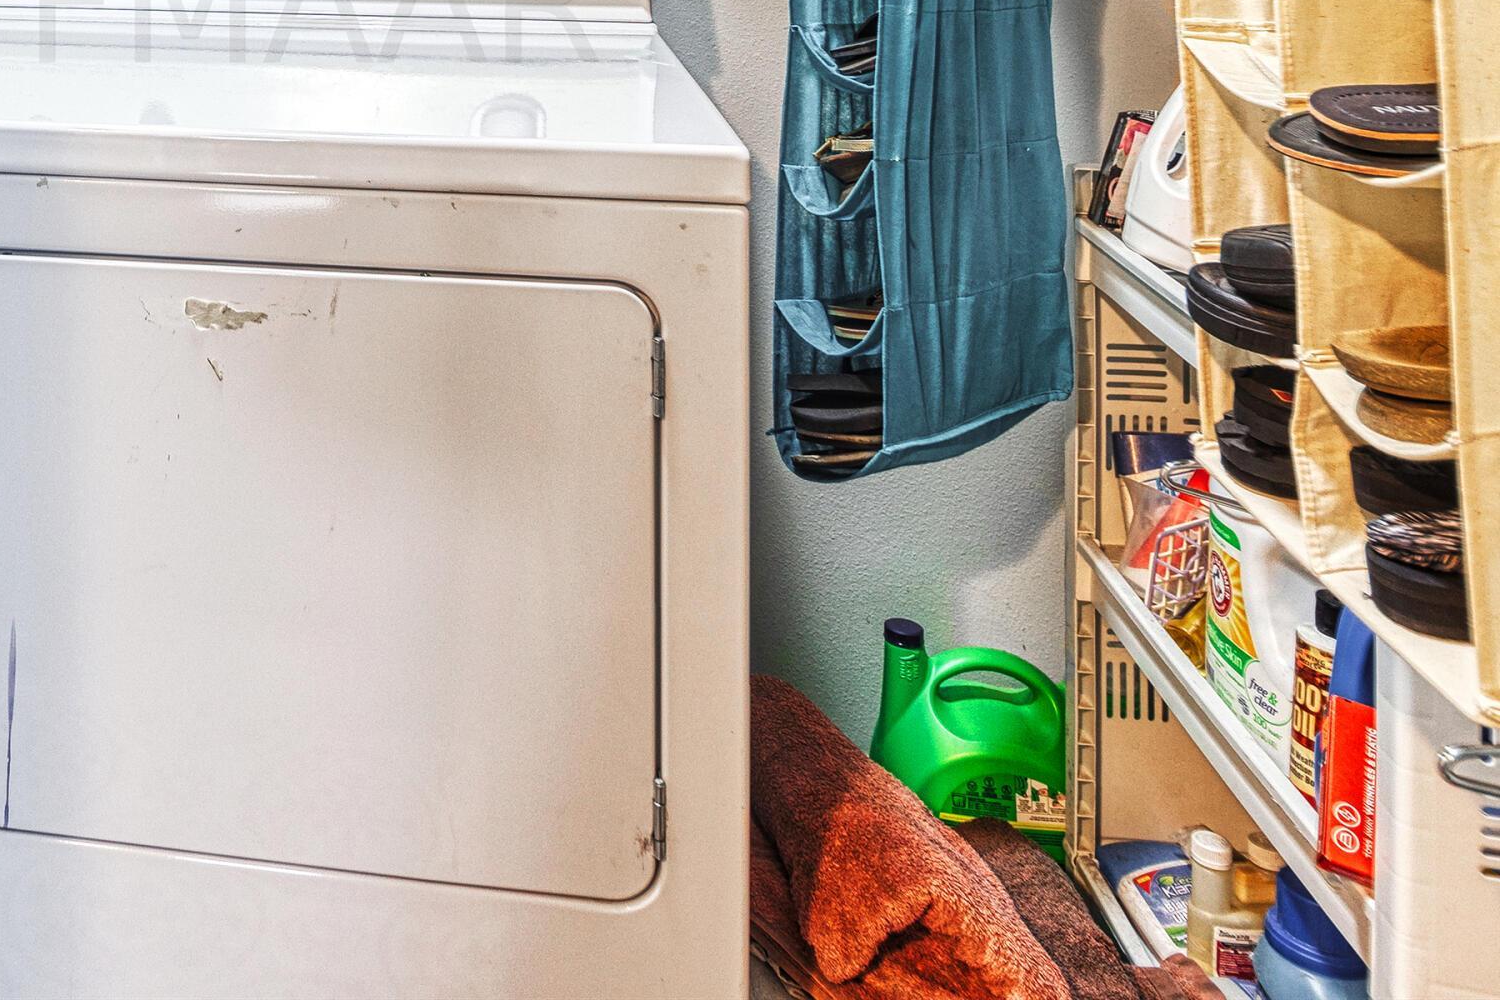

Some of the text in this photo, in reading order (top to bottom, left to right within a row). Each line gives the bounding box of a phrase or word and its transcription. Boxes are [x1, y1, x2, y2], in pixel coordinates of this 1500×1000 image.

[1372, 104, 1443, 114] NAUT
[1223, 643, 1243, 670] Skin
[1249, 678, 1269, 698] free
[1268, 692, 1278, 707] &
[1254, 695, 1278, 717] clear
[1365, 726, 1377, 758] STATIC
[1363, 767, 1376, 816] WRINKLES
